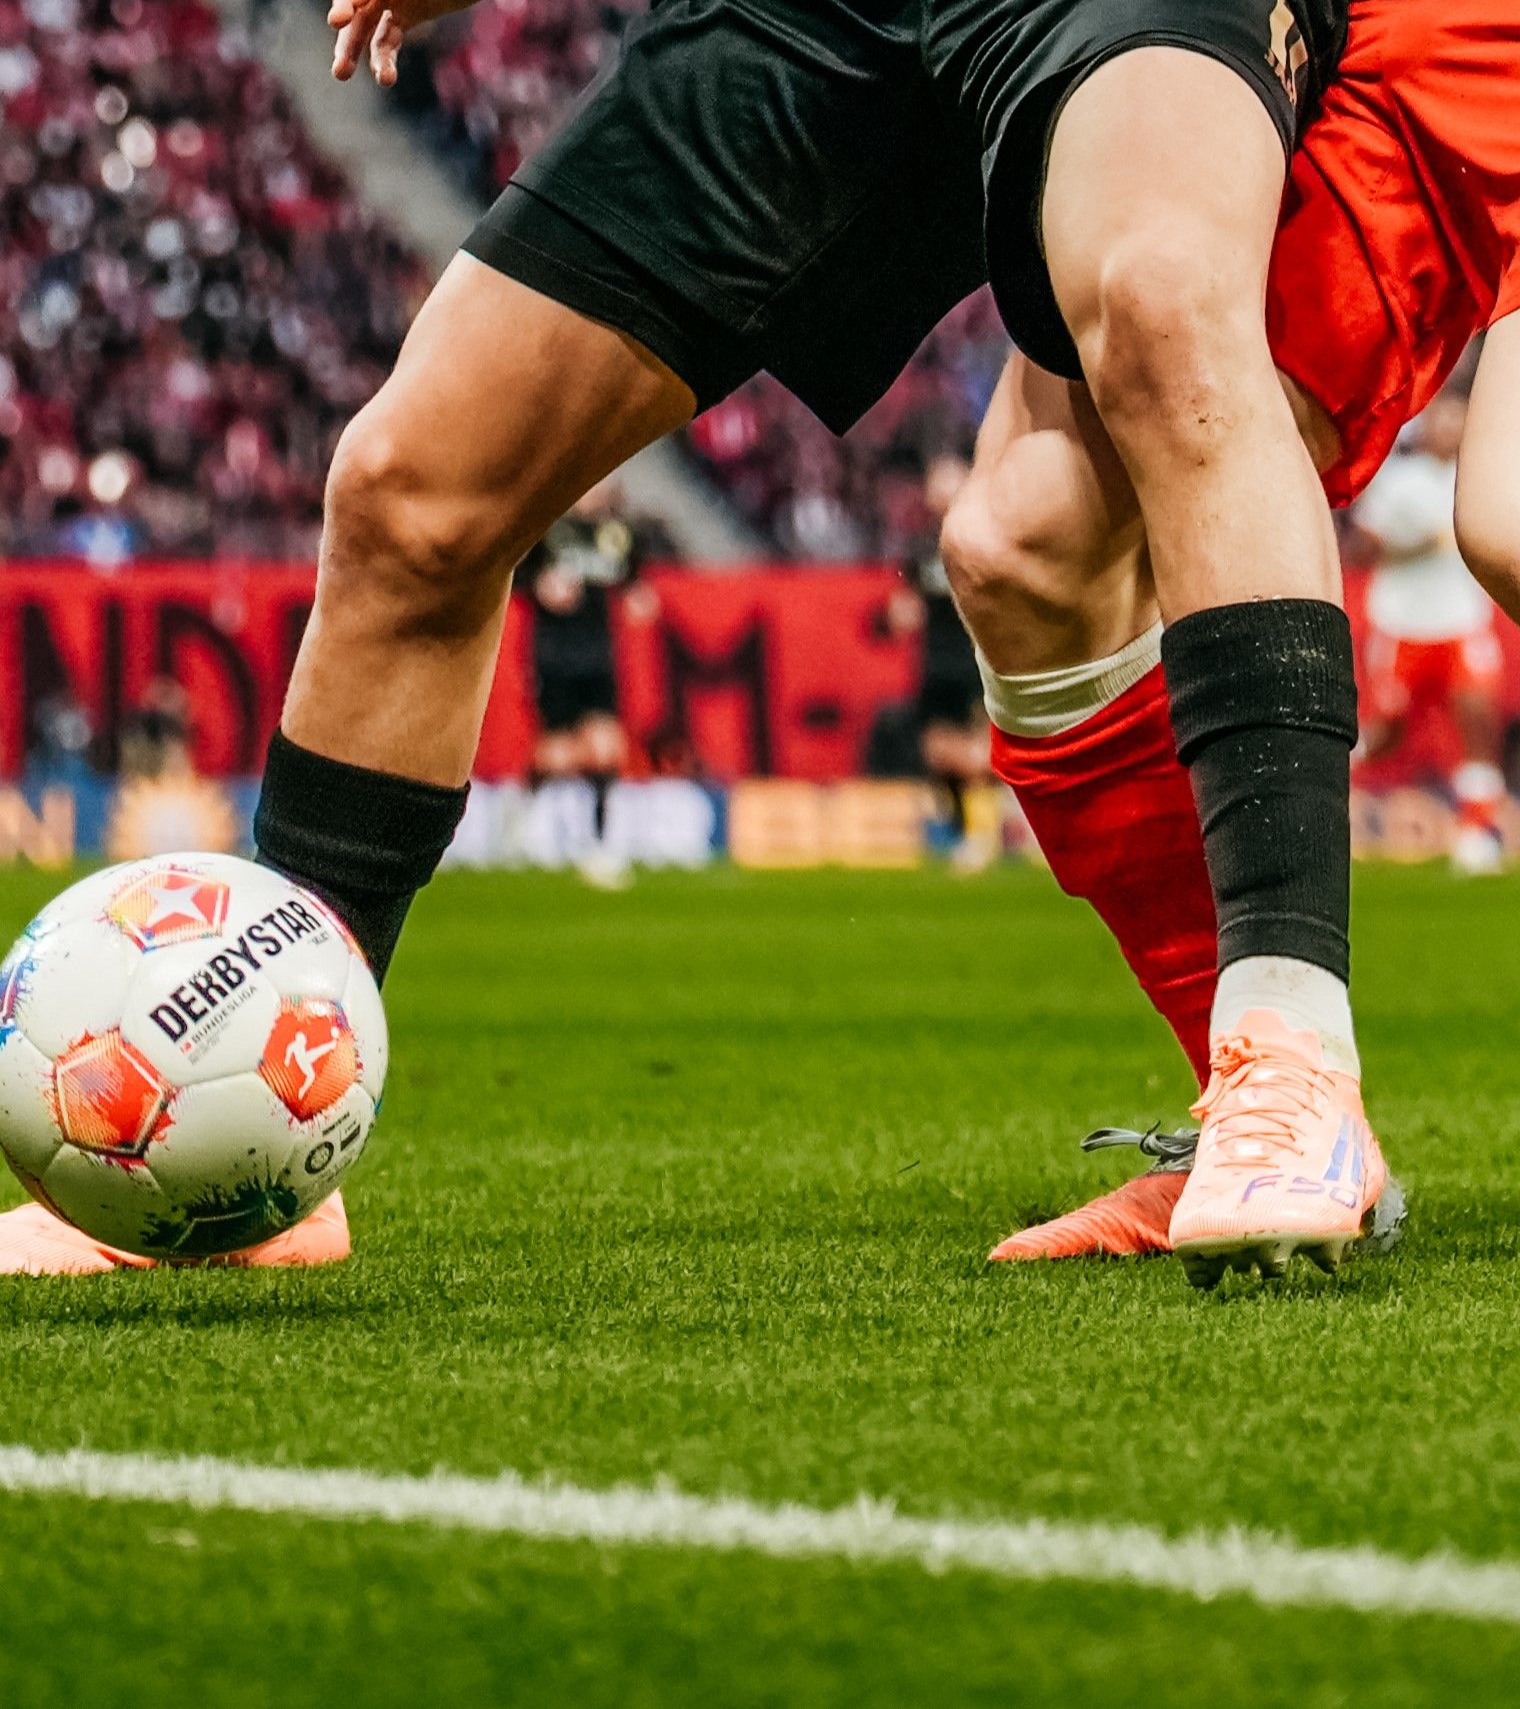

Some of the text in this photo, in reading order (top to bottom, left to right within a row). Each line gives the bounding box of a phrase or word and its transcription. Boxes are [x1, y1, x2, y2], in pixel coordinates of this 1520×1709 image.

[149, 900, 321, 1043] DERBYSTAR
[192, 985, 257, 1045] BUNDESLIGA
[1242, 1174, 1358, 1210] F50
